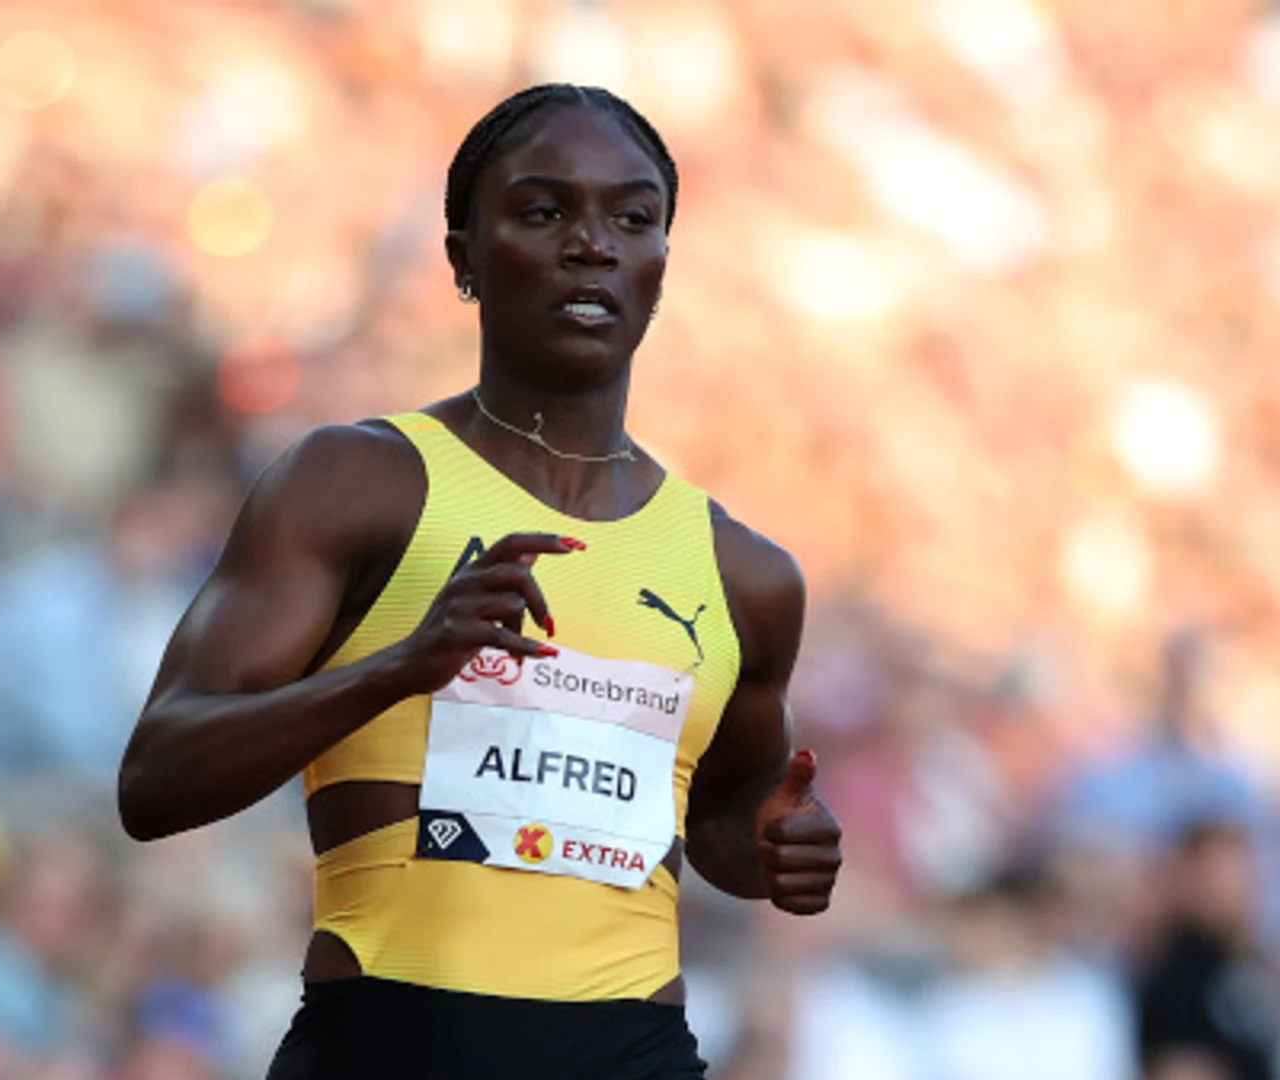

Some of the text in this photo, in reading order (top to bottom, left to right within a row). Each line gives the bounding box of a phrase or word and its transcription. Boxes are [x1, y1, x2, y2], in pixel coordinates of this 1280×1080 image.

[534, 664, 679, 714] Storebrand
[474, 745, 638, 802] ALFRED
[562, 840, 646, 872] EXTRA
